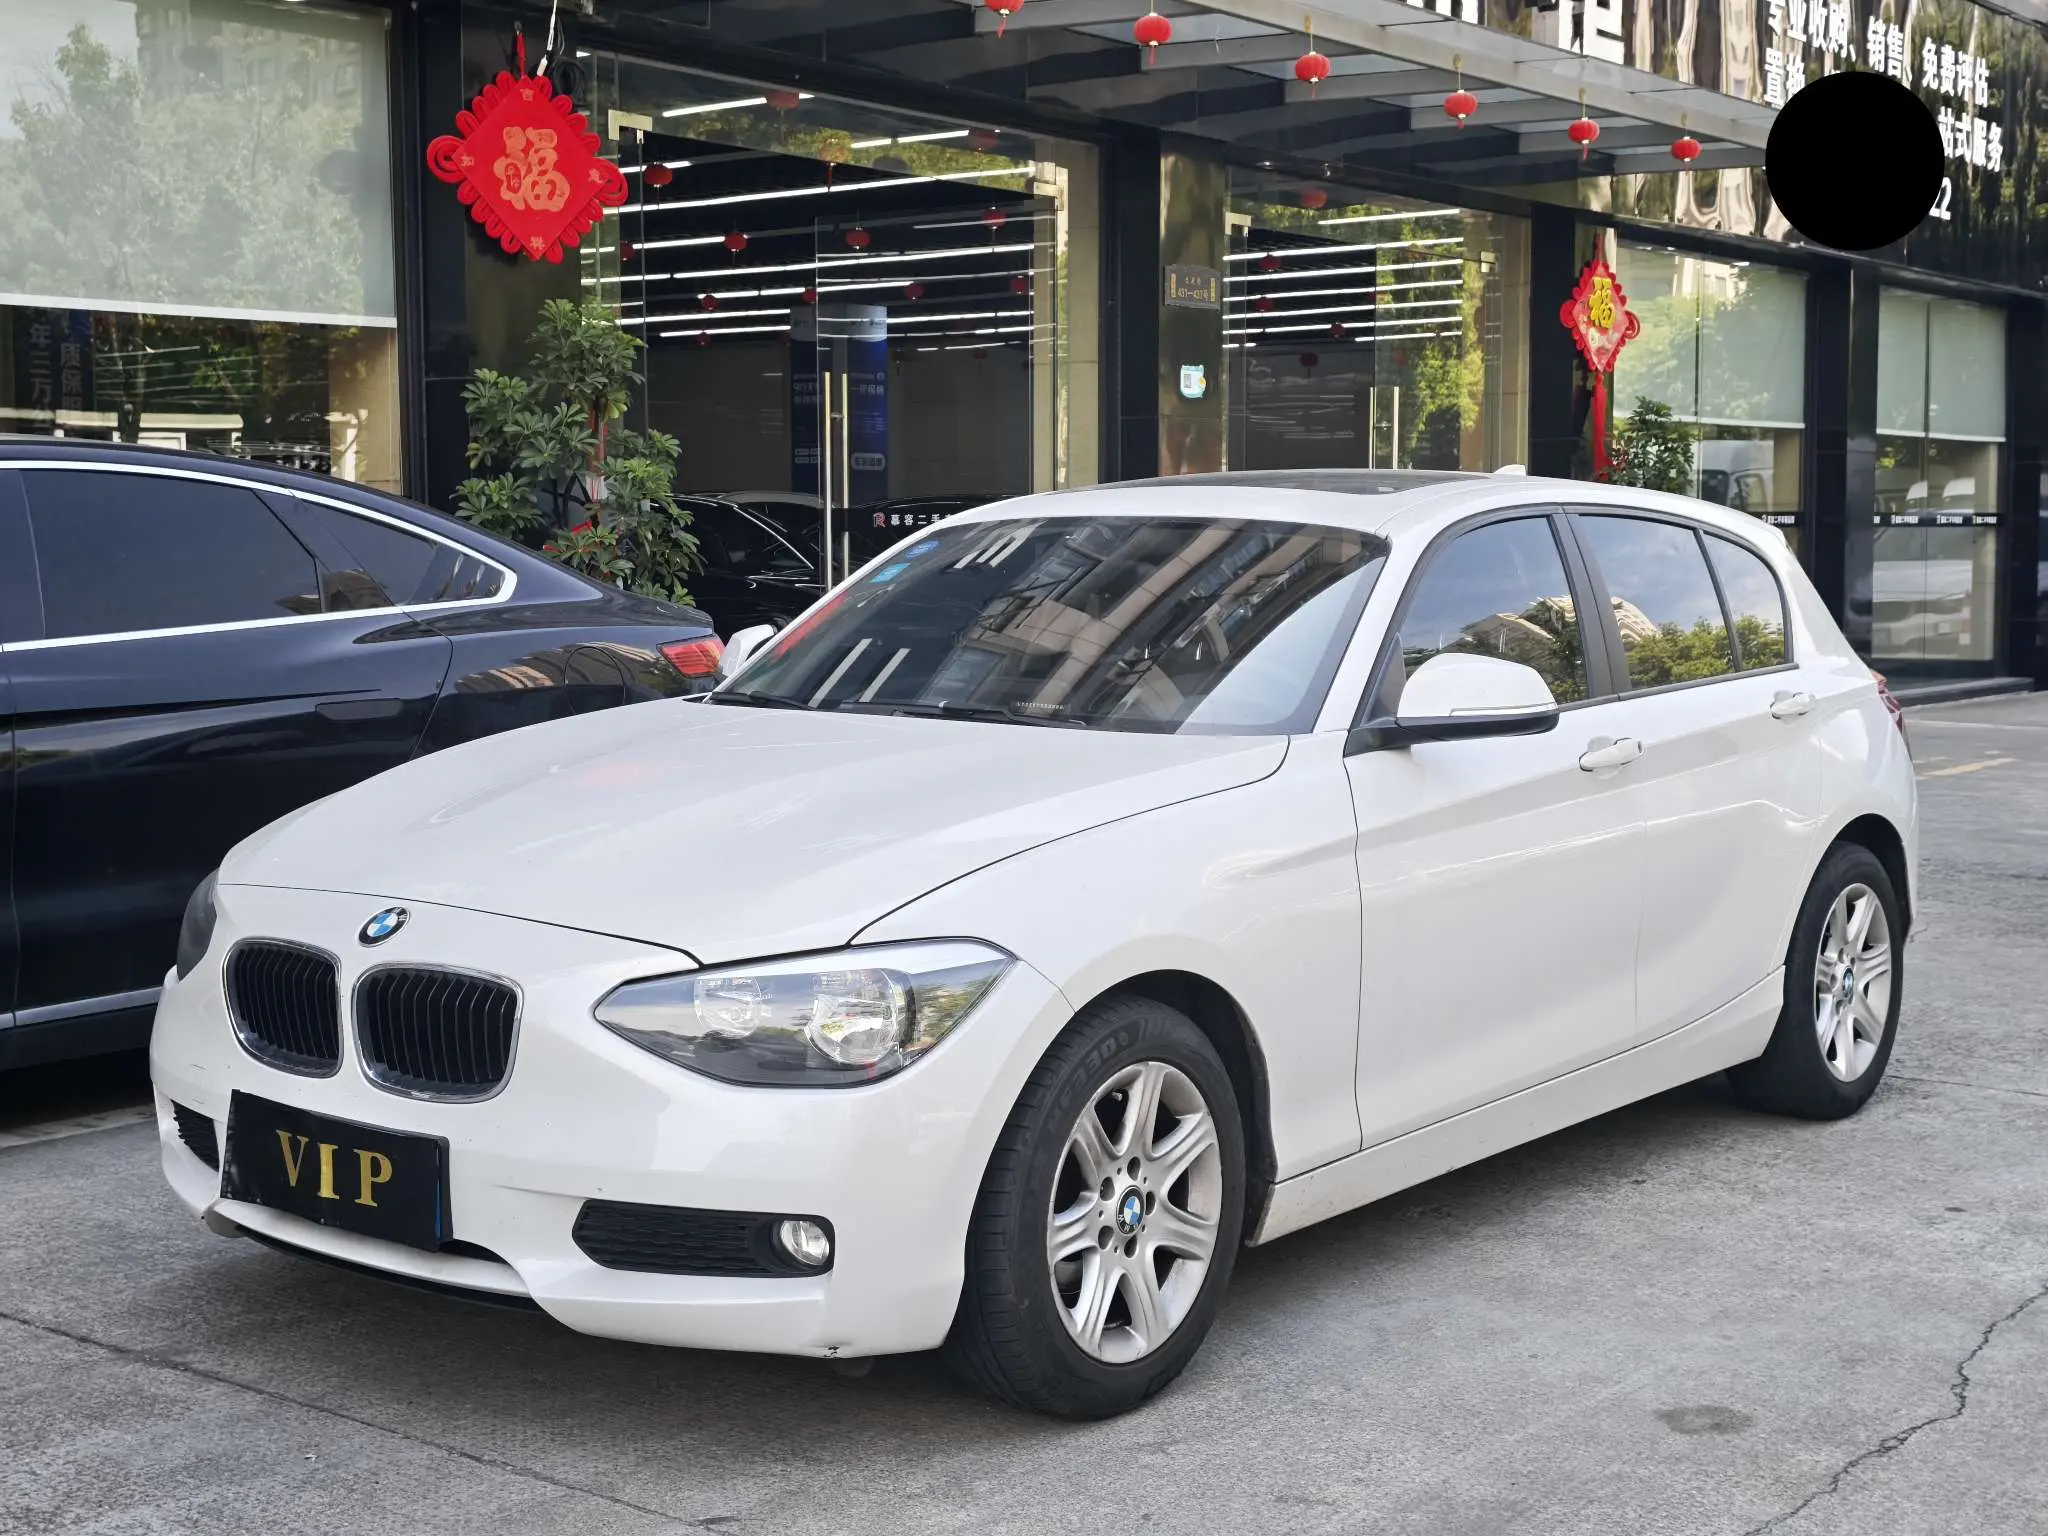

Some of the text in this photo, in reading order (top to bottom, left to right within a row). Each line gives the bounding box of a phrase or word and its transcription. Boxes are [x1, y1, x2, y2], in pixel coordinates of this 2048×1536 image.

[493, 126, 571, 213] 福
[1589, 276, 1616, 329] 福
[275, 1128, 393, 1208] VIP
